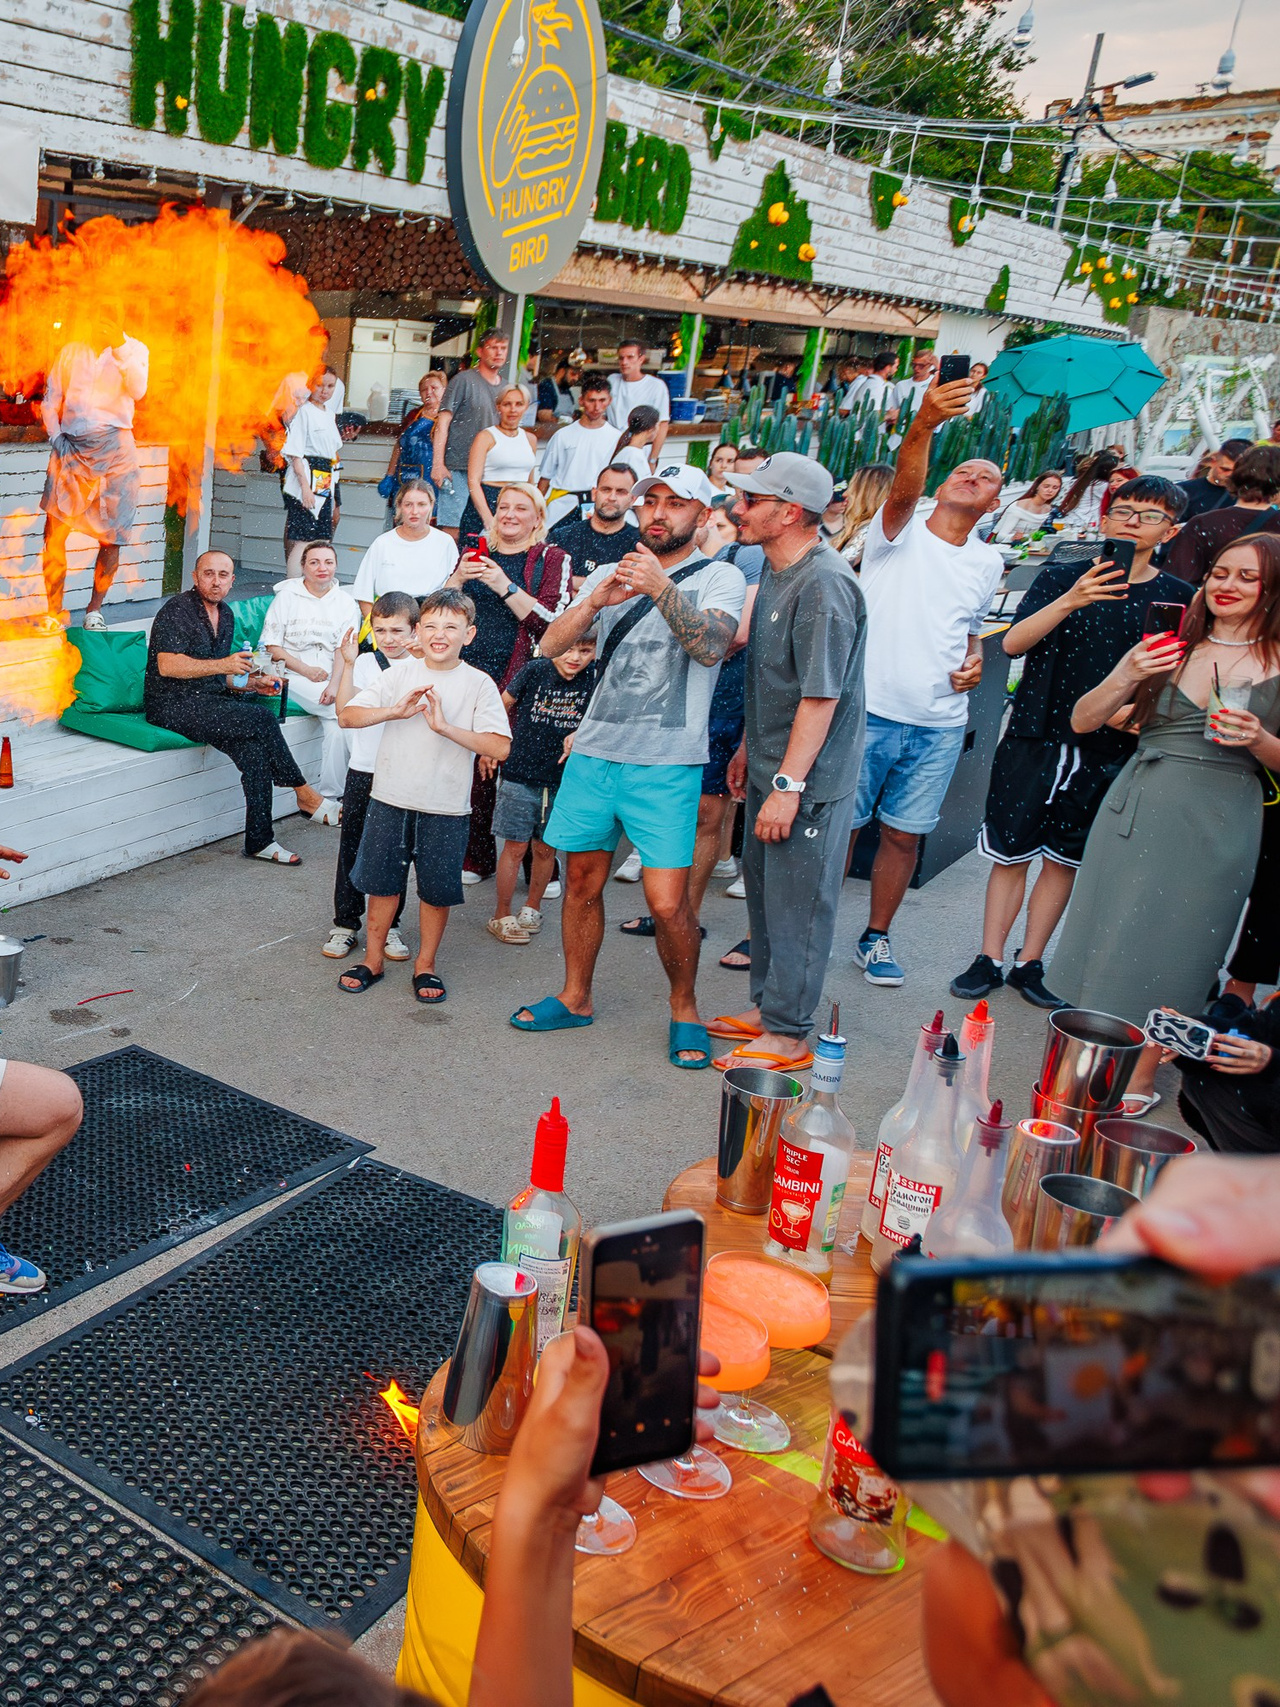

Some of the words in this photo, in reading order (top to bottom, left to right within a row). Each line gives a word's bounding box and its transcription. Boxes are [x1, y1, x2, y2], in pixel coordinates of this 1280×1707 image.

[130, 0, 445, 186] HUNGRY
[593, 118, 692, 236] BIRD
[500, 174, 571, 222] HUNGRY
[508, 233, 549, 273] BIRD
[782, 1144, 809, 1162] TRIPLE
[785, 1154, 801, 1167] SEC
